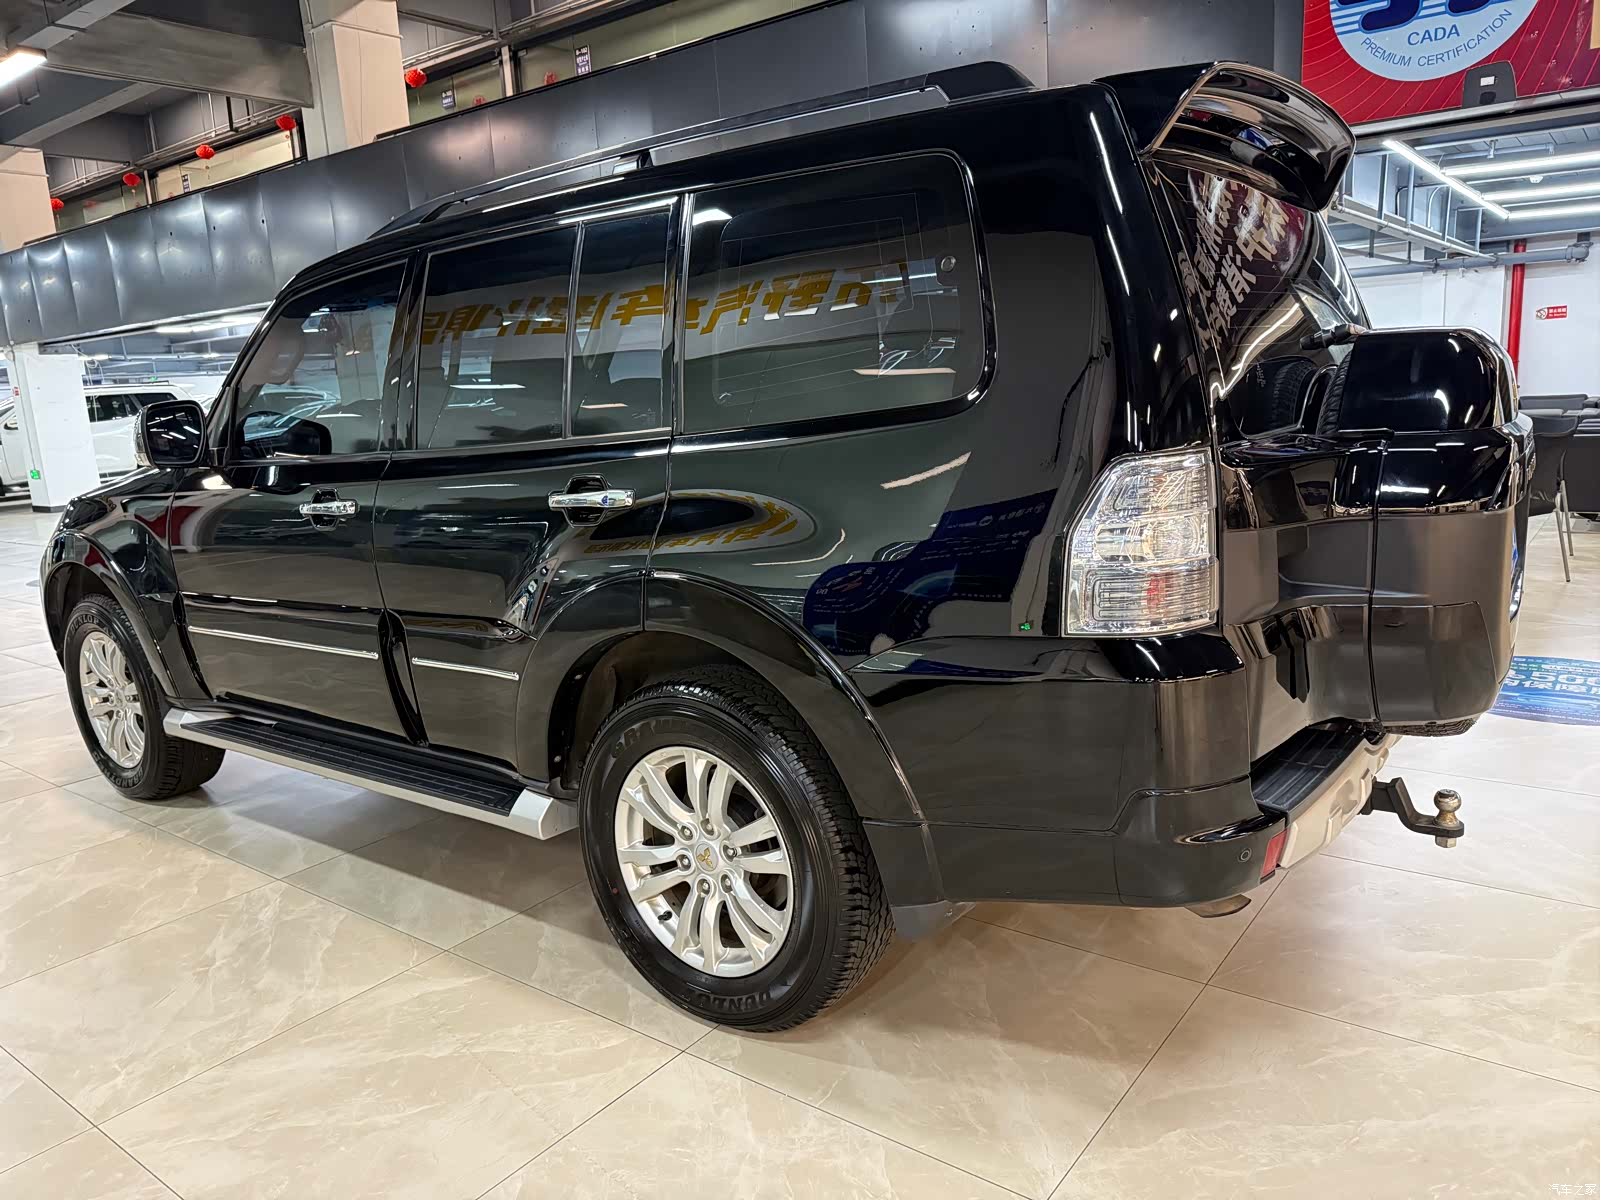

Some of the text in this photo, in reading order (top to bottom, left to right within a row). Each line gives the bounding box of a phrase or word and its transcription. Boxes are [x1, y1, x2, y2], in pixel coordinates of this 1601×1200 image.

[1360, 37, 1412, 67] PREMIUM
[1417, 8, 1512, 67] CERTIFICATION
[1407, 23, 1460, 46] CADA
